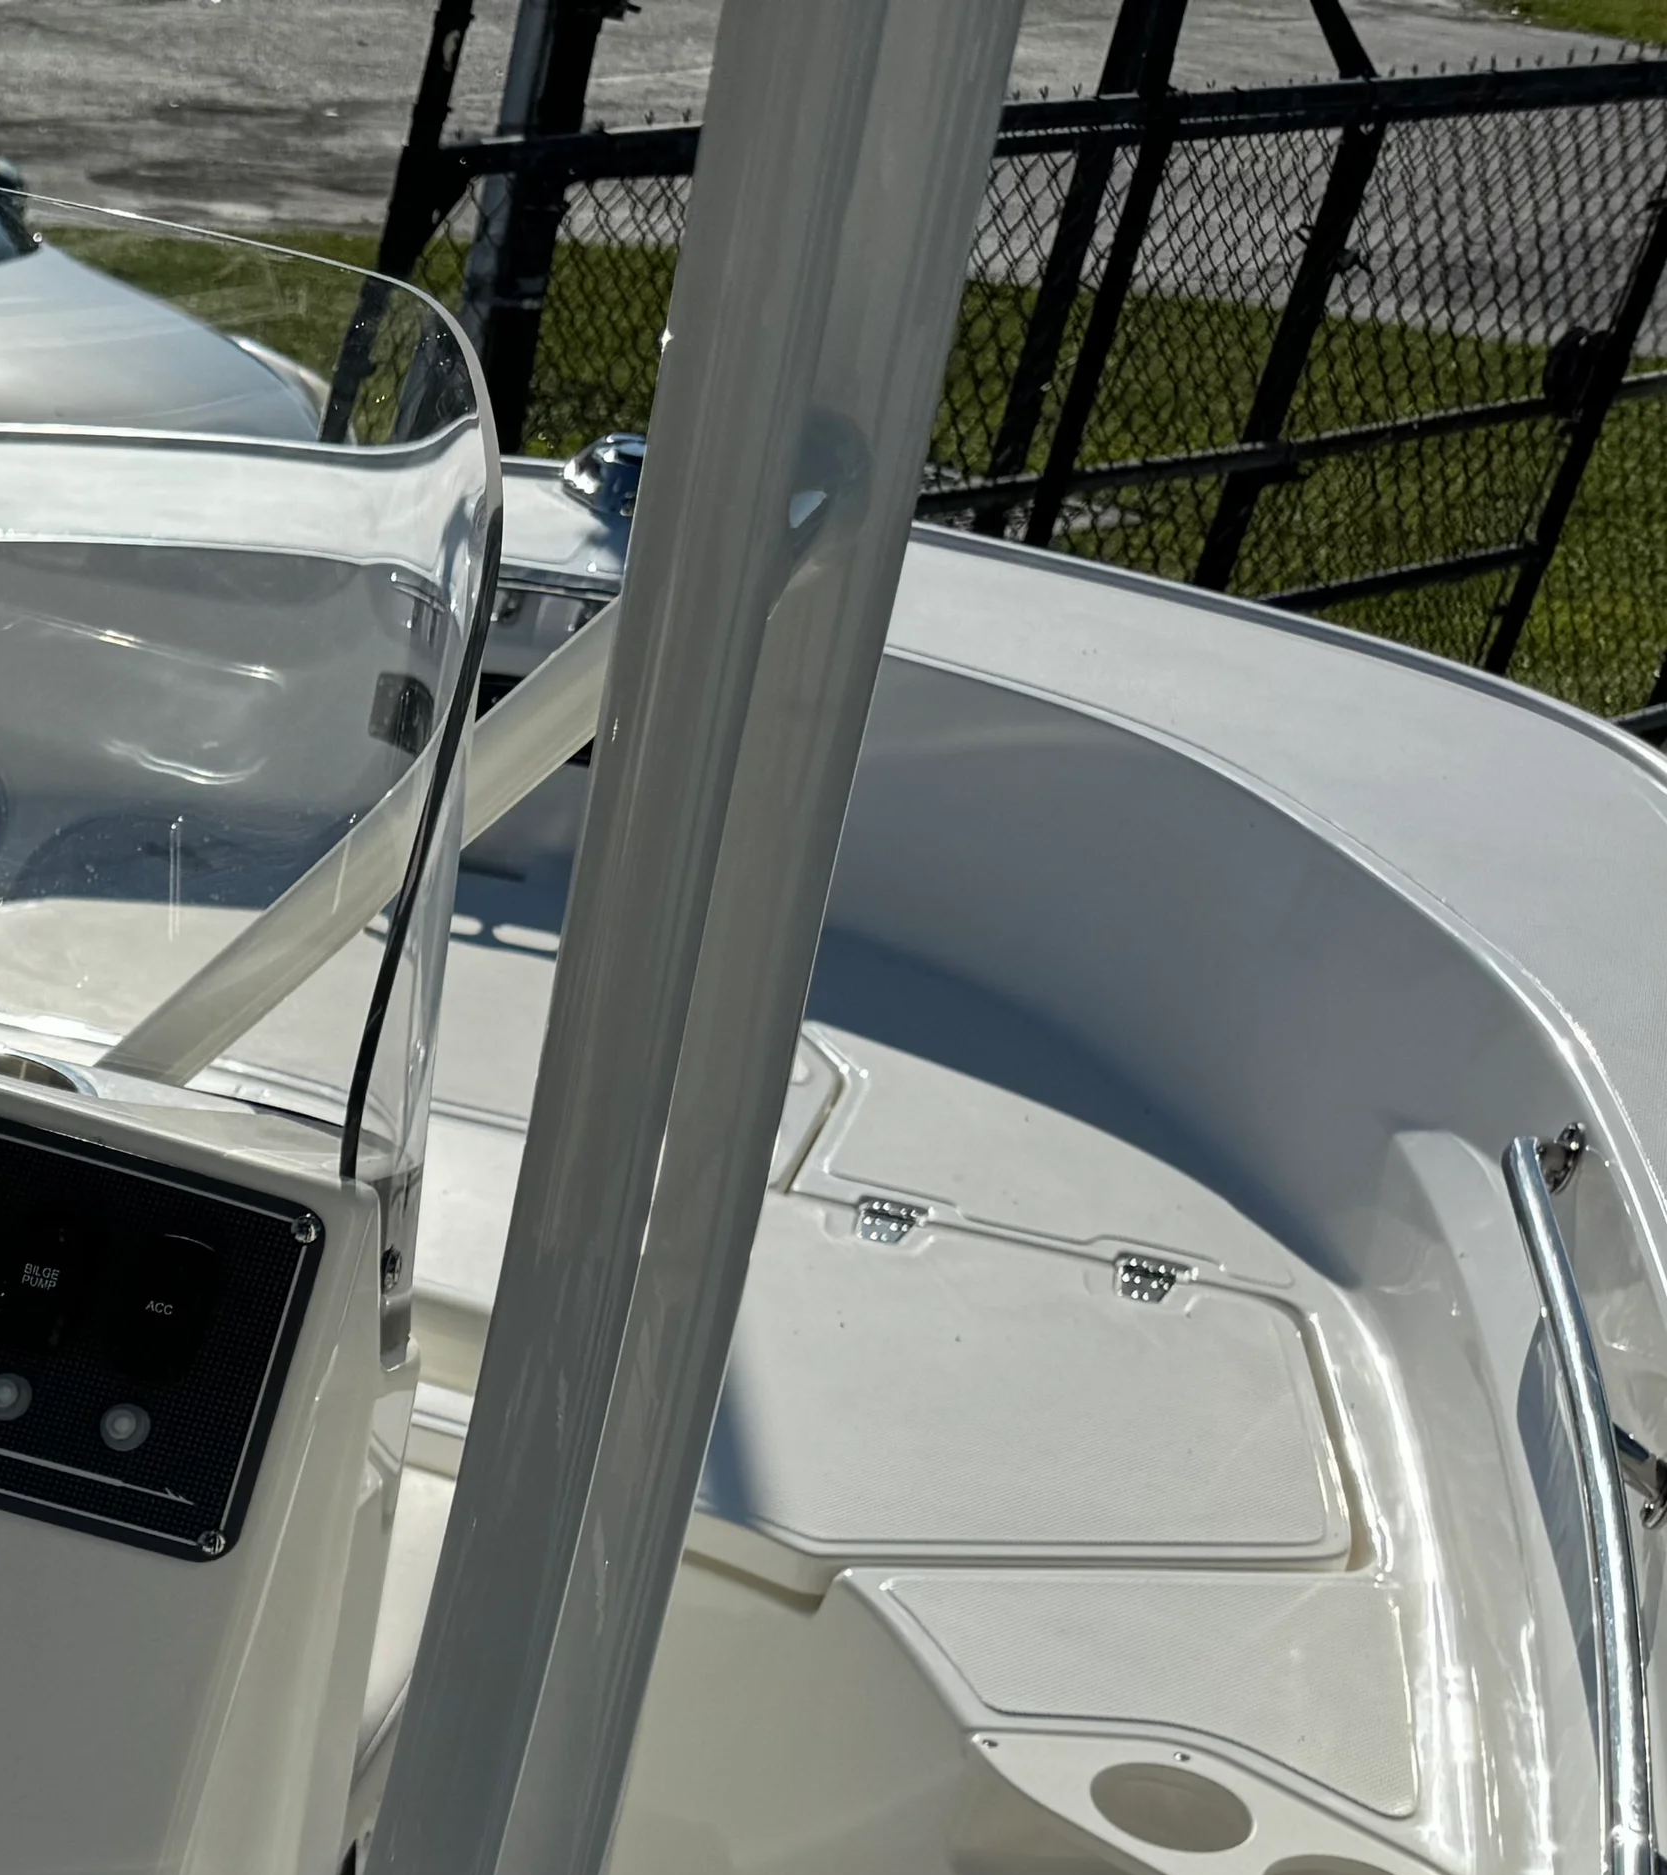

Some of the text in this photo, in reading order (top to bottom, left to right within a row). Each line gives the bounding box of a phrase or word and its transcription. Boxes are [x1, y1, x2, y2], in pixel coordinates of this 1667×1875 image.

[24, 1263, 61, 1281] BILGE
[21, 1274, 57, 1291] PUMP
[146, 1300, 173, 1316] ACC
